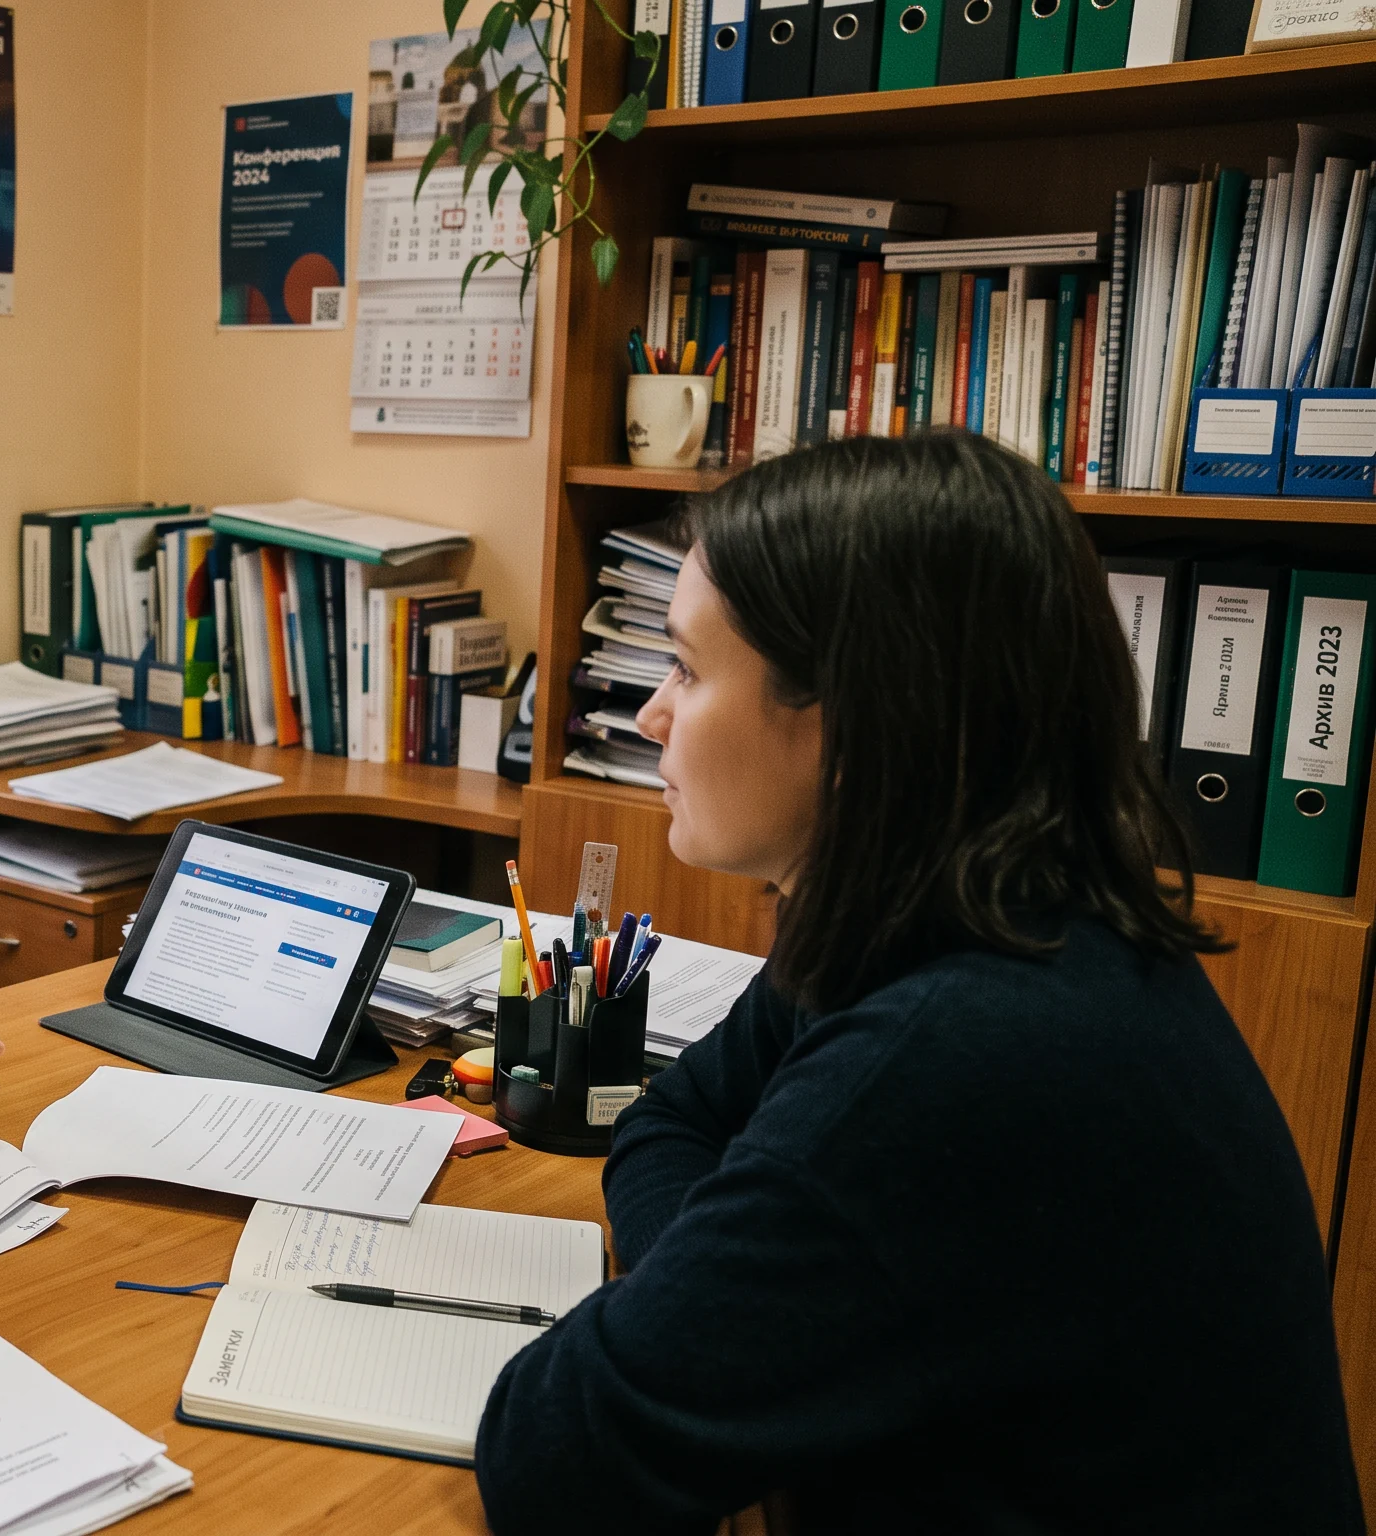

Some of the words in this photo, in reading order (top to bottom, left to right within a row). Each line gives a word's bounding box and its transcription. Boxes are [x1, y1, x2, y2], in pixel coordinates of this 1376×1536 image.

[232, 168, 270, 186] 2024
[233, 145, 341, 166] Конференция
[1316, 626, 1342, 678] 2023
[1308, 683, 1335, 750] Архив
[209, 1329, 244, 1387] Заметки
